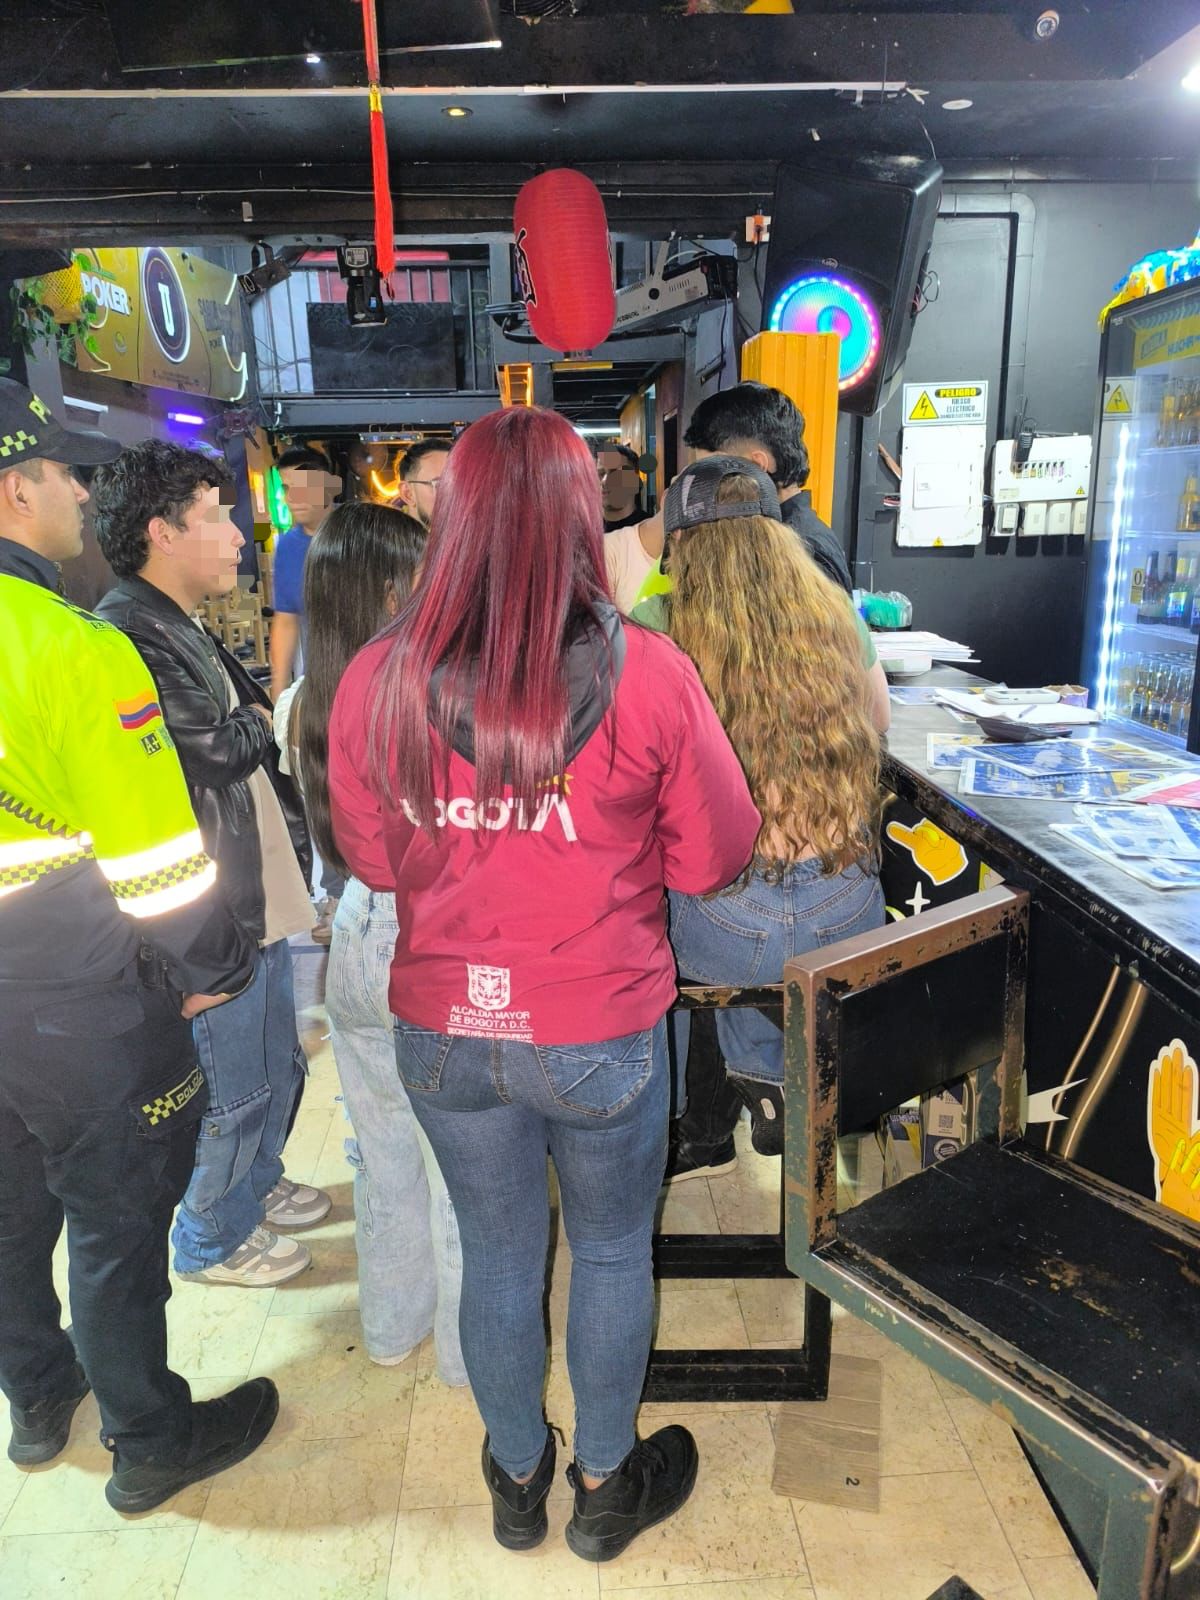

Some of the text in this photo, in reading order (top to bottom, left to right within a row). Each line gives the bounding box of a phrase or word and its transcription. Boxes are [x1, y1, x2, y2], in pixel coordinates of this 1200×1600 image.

[80, 272, 130, 316] POKER
[940, 387, 976, 398] PELIGRO
[449, 1013, 462, 1024] DE
[509, 1020, 531, 1029] D.C.
[495, 1011, 530, 1020] MAYOR
[845, 1476, 860, 1486] 2
